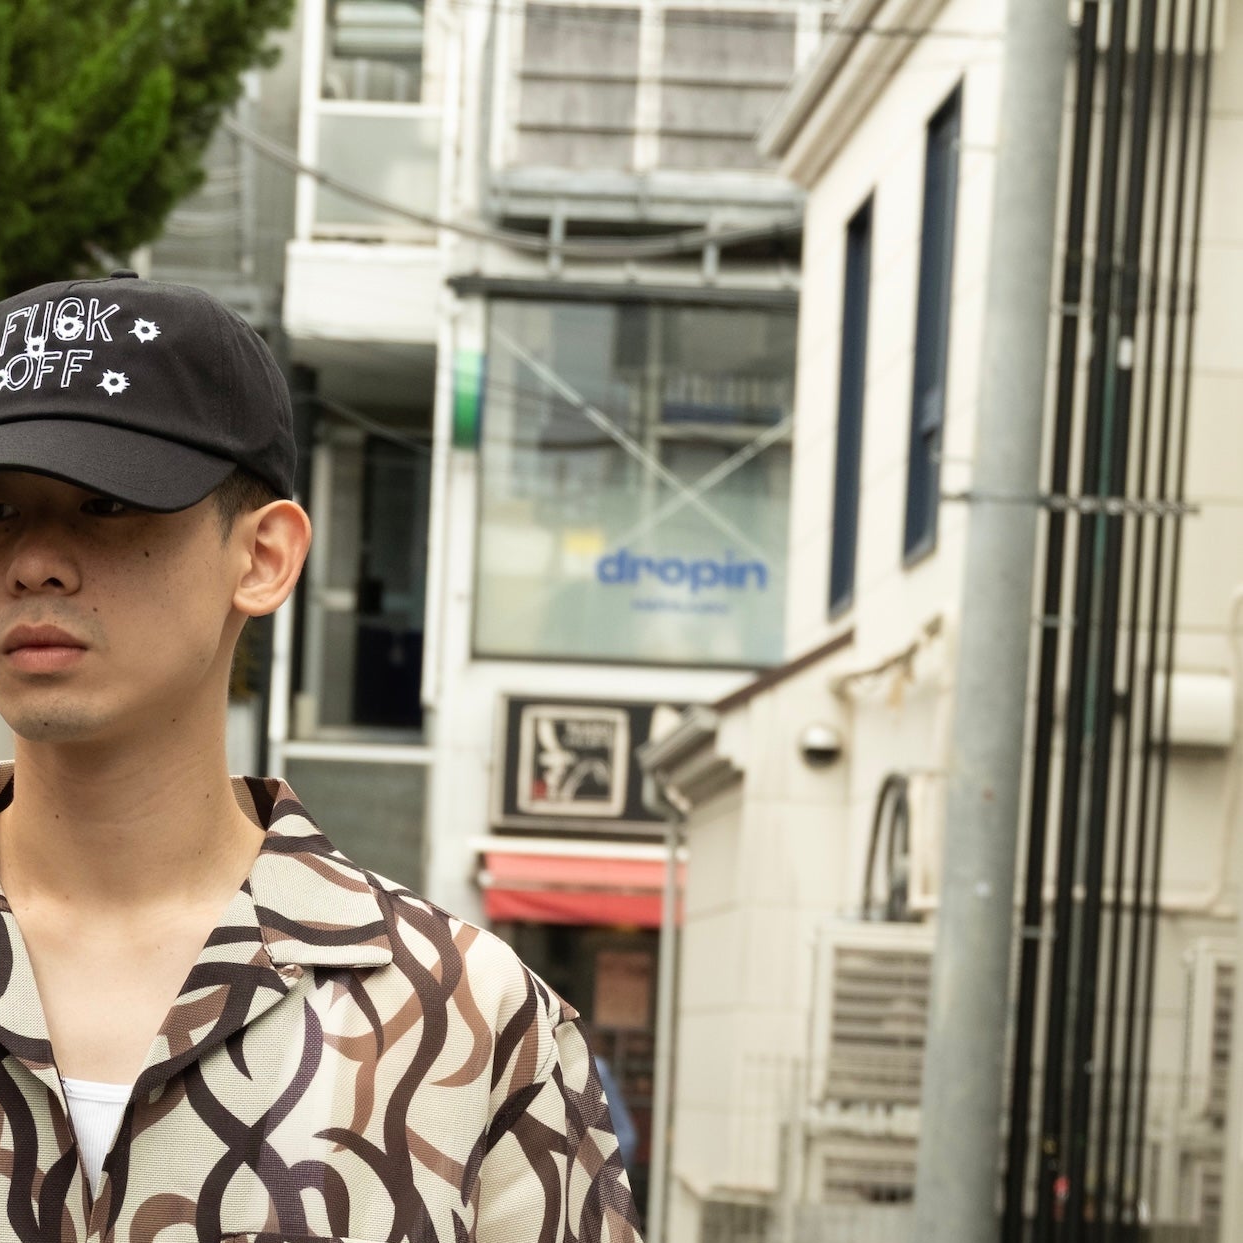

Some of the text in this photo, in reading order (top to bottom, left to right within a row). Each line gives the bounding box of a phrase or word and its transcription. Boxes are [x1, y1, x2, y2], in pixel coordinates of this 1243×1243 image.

[0, 297, 120, 357] FUCK
[5, 350, 93, 391] OFF
[596, 547, 768, 592] dropin
